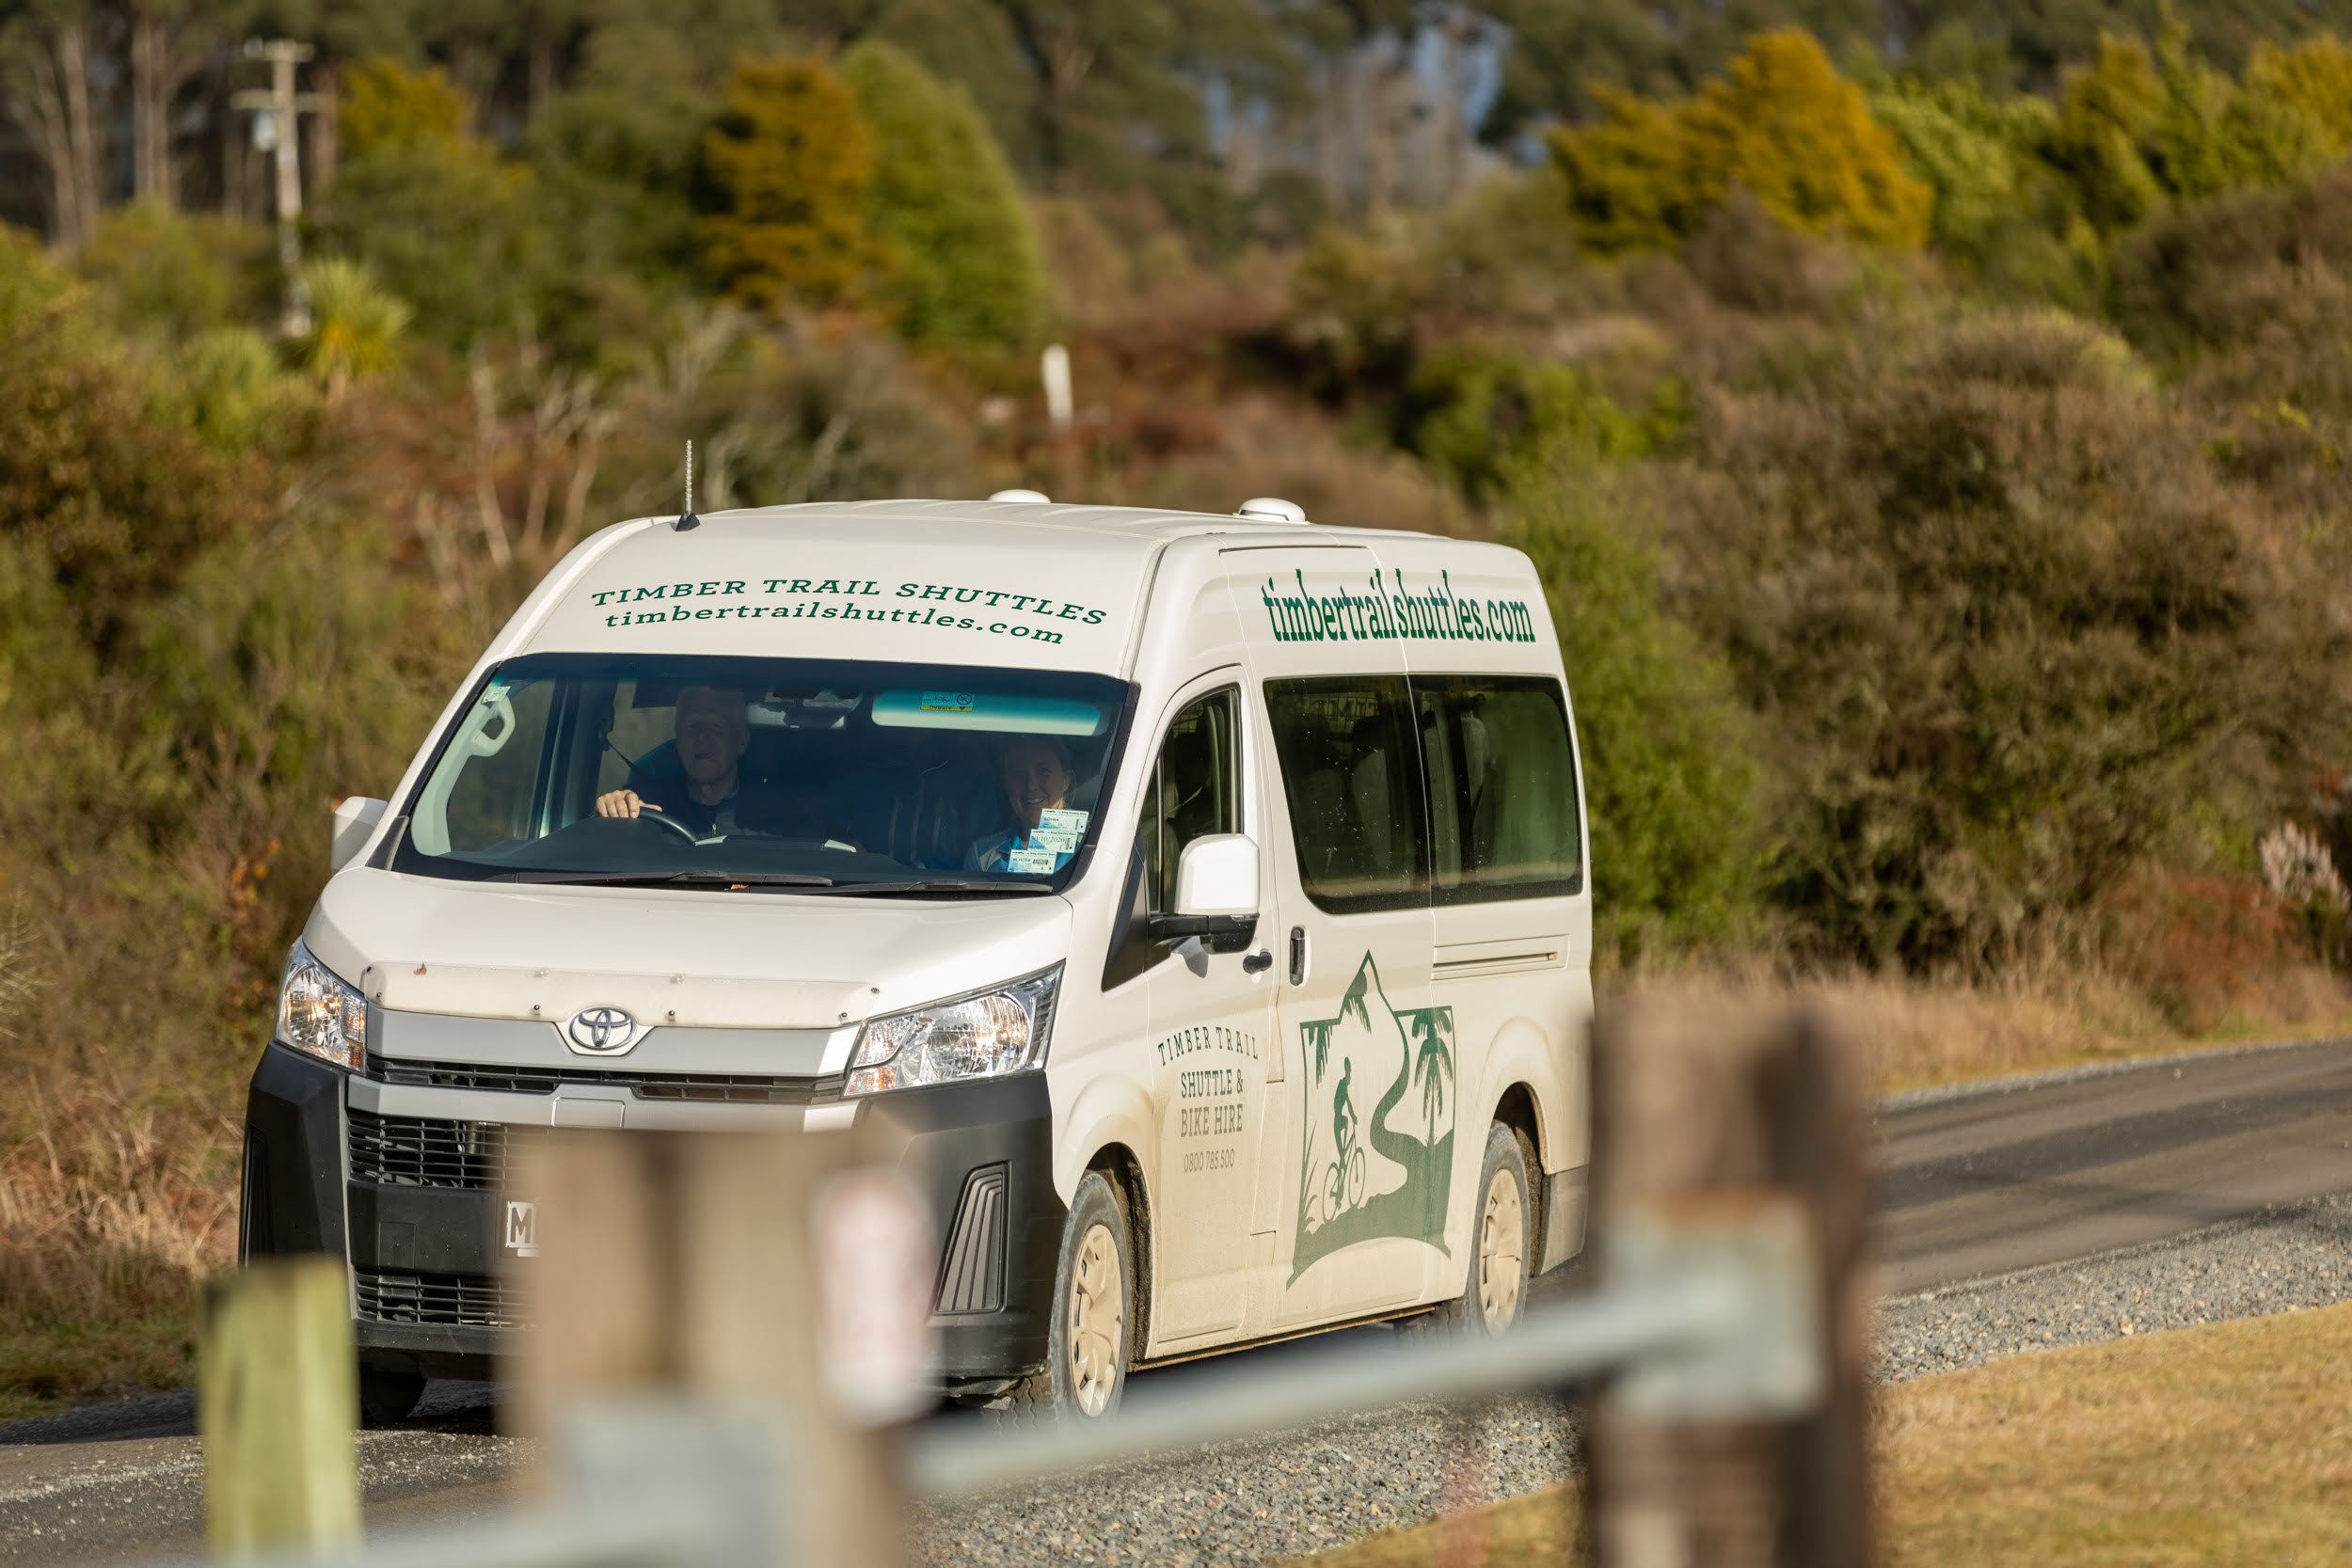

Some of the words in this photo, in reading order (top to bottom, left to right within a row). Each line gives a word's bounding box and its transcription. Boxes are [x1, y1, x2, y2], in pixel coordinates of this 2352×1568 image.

[591, 580, 746, 607] TIMBER
[763, 578, 881, 596] TRAIL
[896, 583, 1107, 625] SHUTTLES
[1261, 568, 1536, 642] timbertrailshuttles.com
[605, 602, 1064, 644] timbertrailshuttles.com
[1157, 1026, 1212, 1067] TIMBER
[1216, 1026, 1259, 1060] TRAIL
[1181, 1069, 1232, 1099] SHUTTLE
[1236, 1069, 1244, 1094] &
[1180, 1106, 1210, 1138] BIKE
[1214, 1103, 1244, 1135] HIRE
[1184, 1152, 1204, 1173] 0800
[1205, 1150, 1219, 1170] 785
[1220, 1148, 1235, 1168] 500
